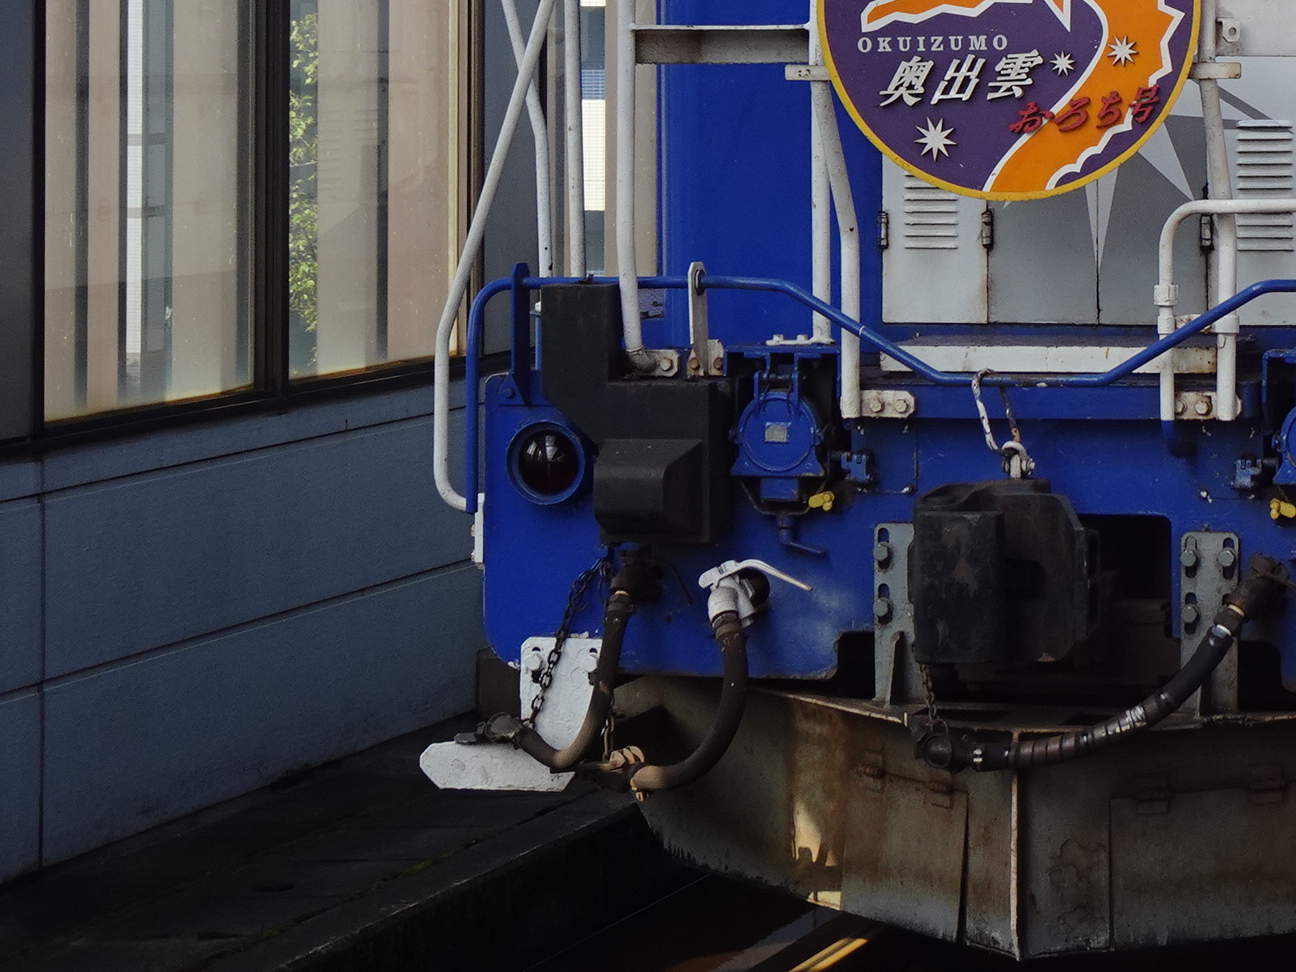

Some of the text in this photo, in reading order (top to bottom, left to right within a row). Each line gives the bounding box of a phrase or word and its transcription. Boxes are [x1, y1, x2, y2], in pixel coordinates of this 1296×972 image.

[857, 34, 1008, 53] OKUIZUMO
[879, 48, 1044, 108] 奥出雲
[1009, 84, 1161, 134] おろち号
